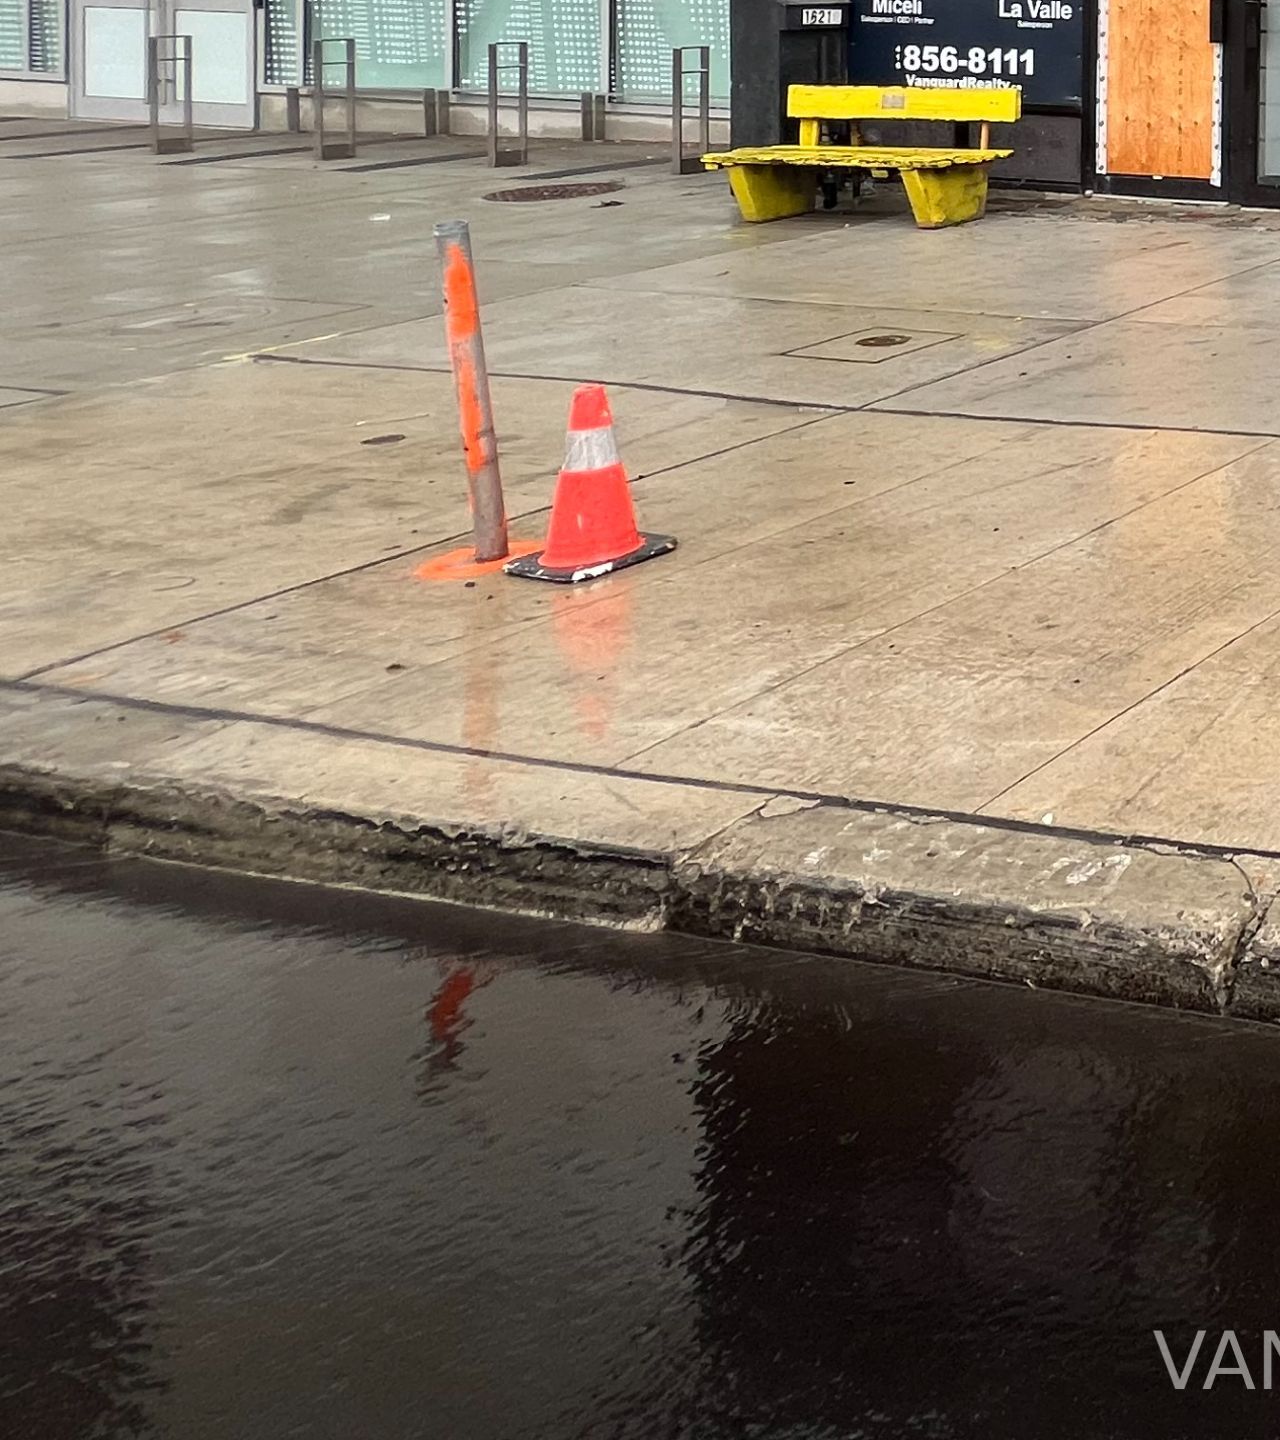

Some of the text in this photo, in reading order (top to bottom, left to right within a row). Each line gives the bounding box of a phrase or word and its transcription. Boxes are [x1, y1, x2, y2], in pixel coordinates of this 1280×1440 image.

[998, 0, 1073, 20] La Valle
[903, 44, 1035, 76] 856-8111
